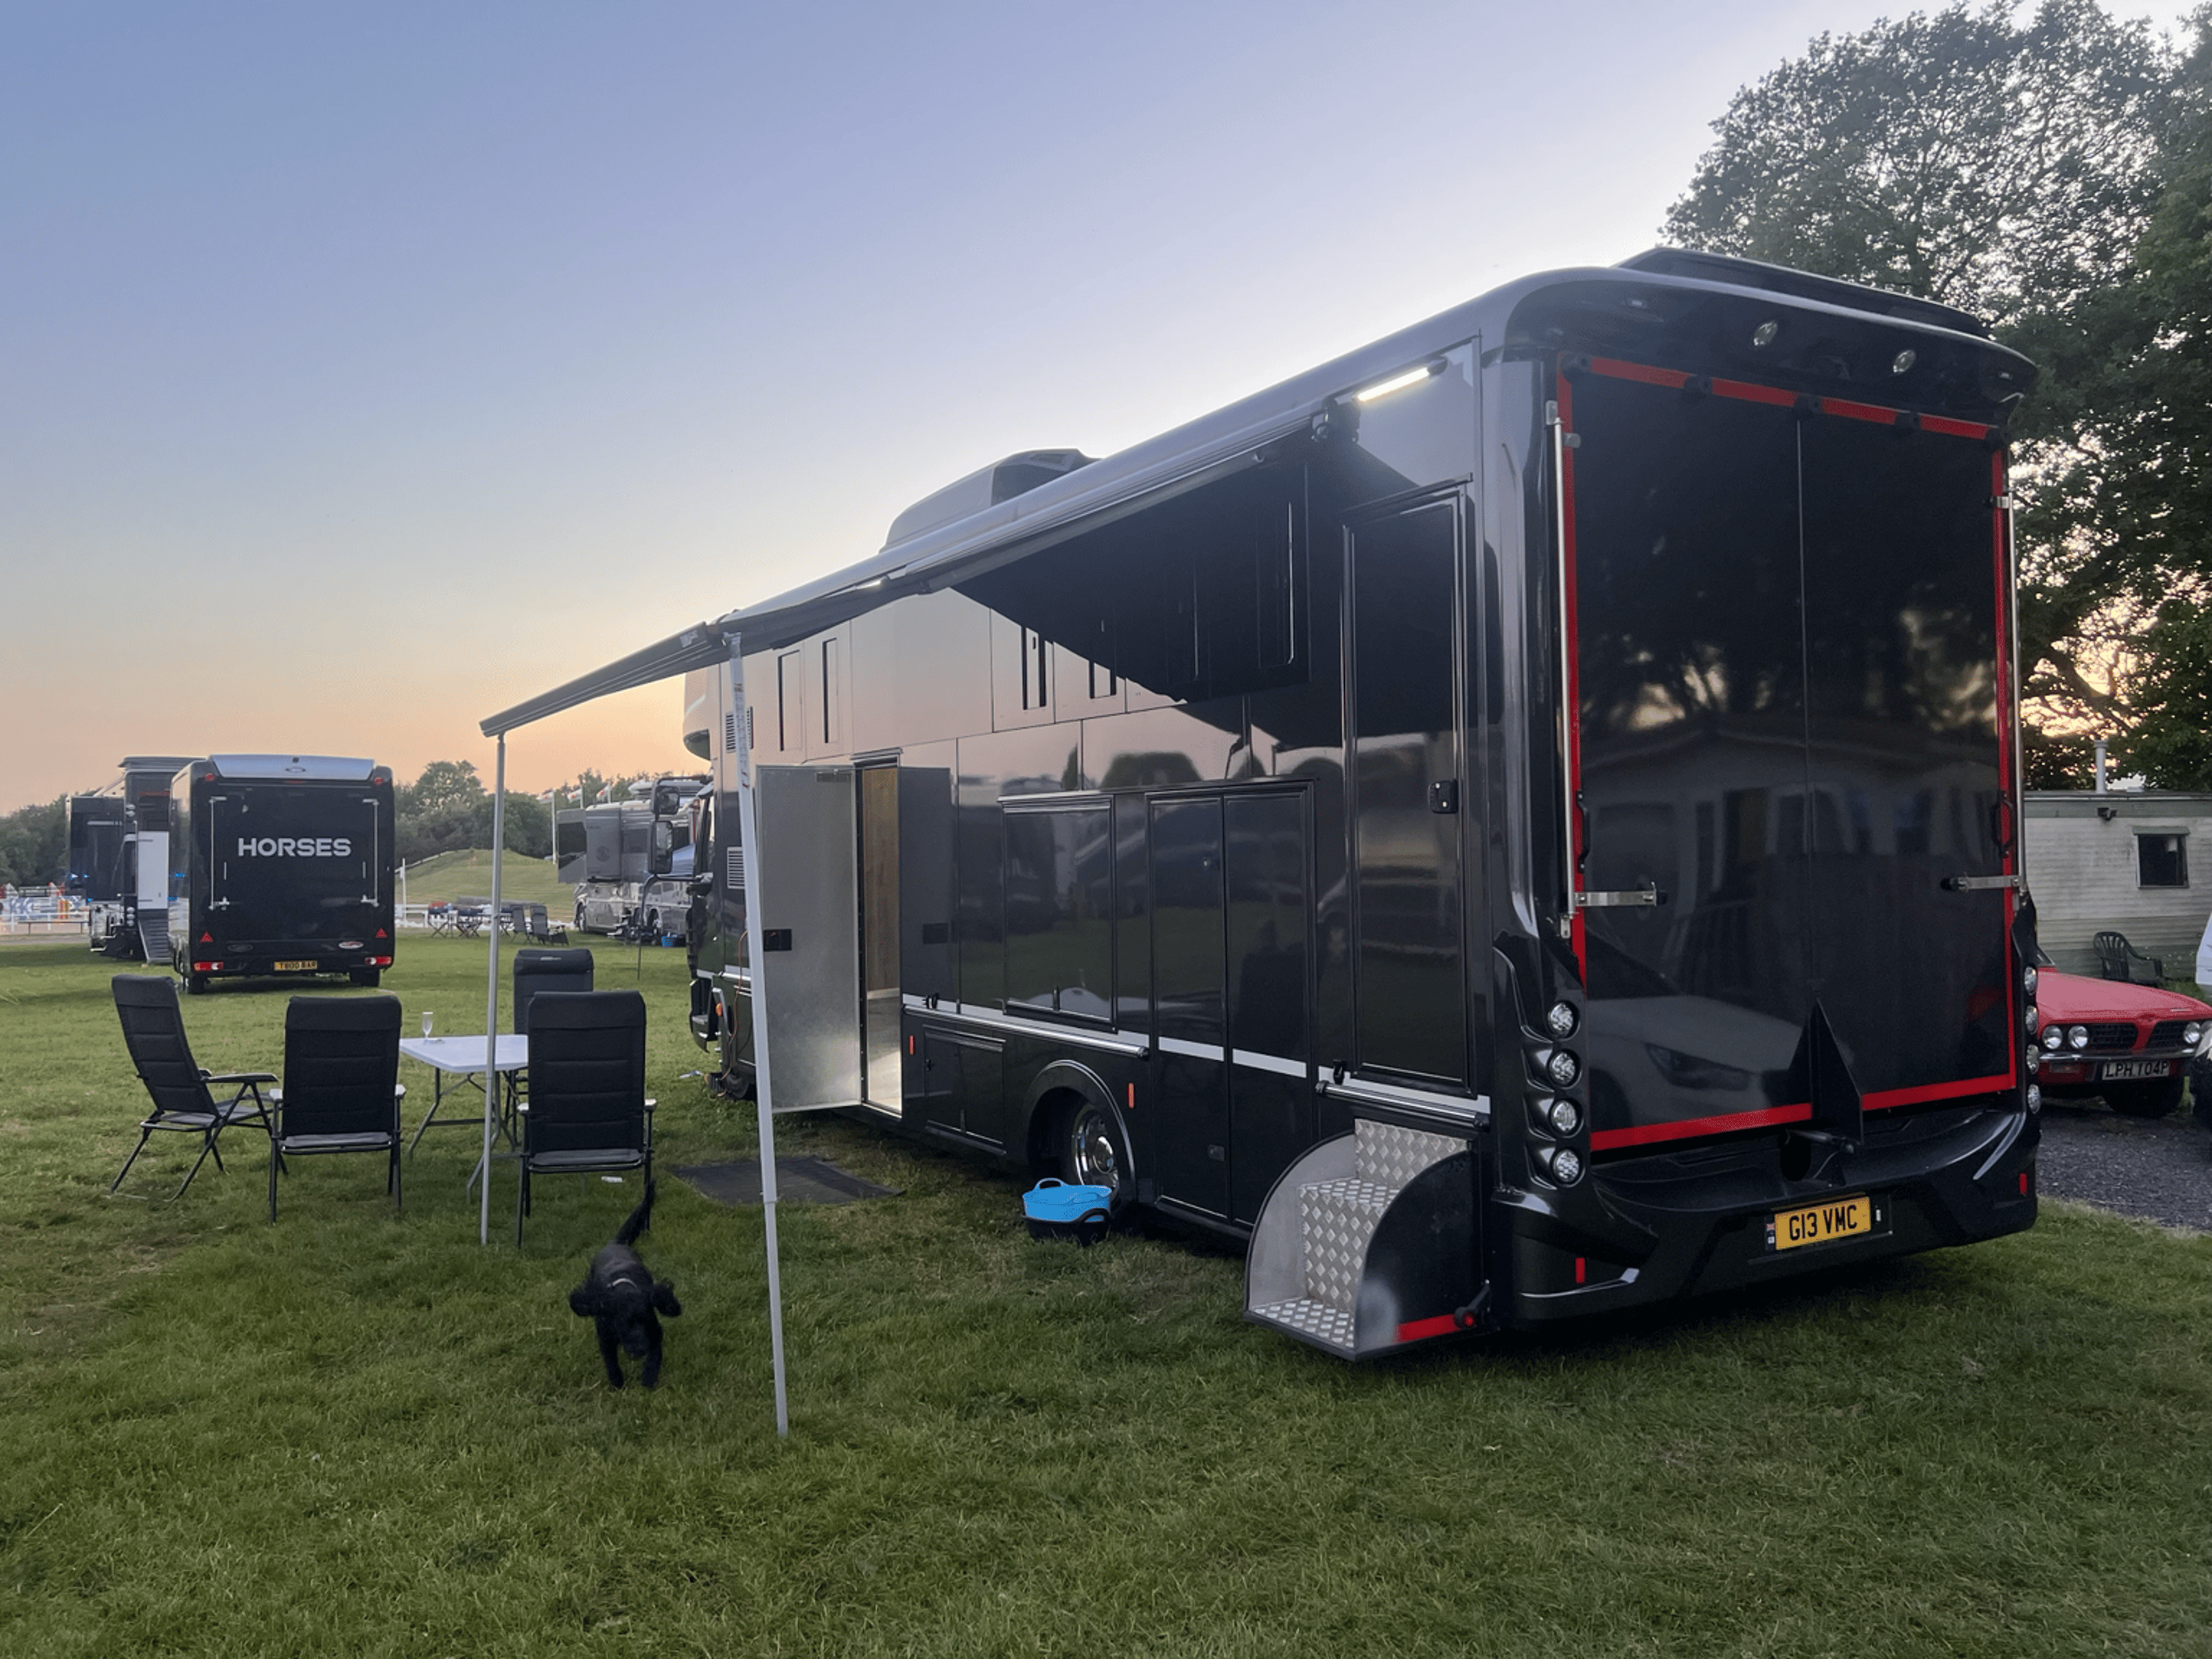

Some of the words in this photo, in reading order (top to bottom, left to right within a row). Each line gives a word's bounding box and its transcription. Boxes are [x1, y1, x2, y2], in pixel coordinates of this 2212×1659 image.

[238, 837, 351, 857] HORSES
[2105, 1063, 2133, 1077] LPH
[2138, 1061, 2168, 1076] 104P
[1789, 1212, 1817, 1241] G13
[1822, 1204, 1857, 1235] VMC
